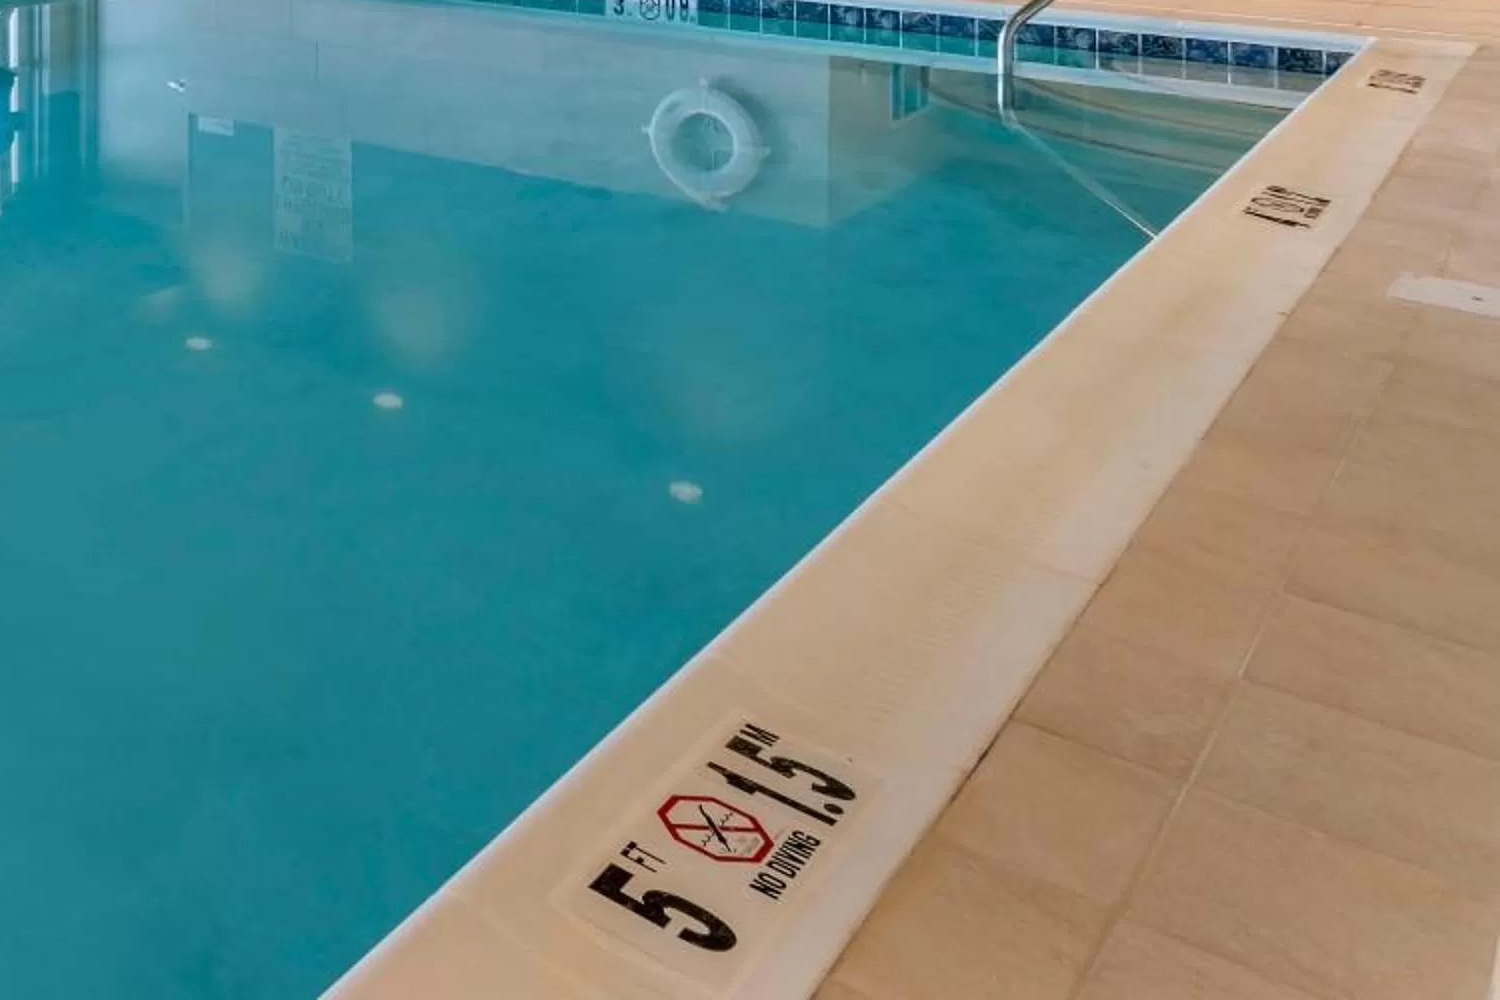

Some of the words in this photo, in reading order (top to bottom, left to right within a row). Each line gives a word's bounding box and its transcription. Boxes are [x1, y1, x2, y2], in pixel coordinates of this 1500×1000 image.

[620, 841, 666, 872] FT
[766, 830, 820, 879] DIVING
[748, 871, 787, 900] NO
[588, 863, 737, 951] 5
